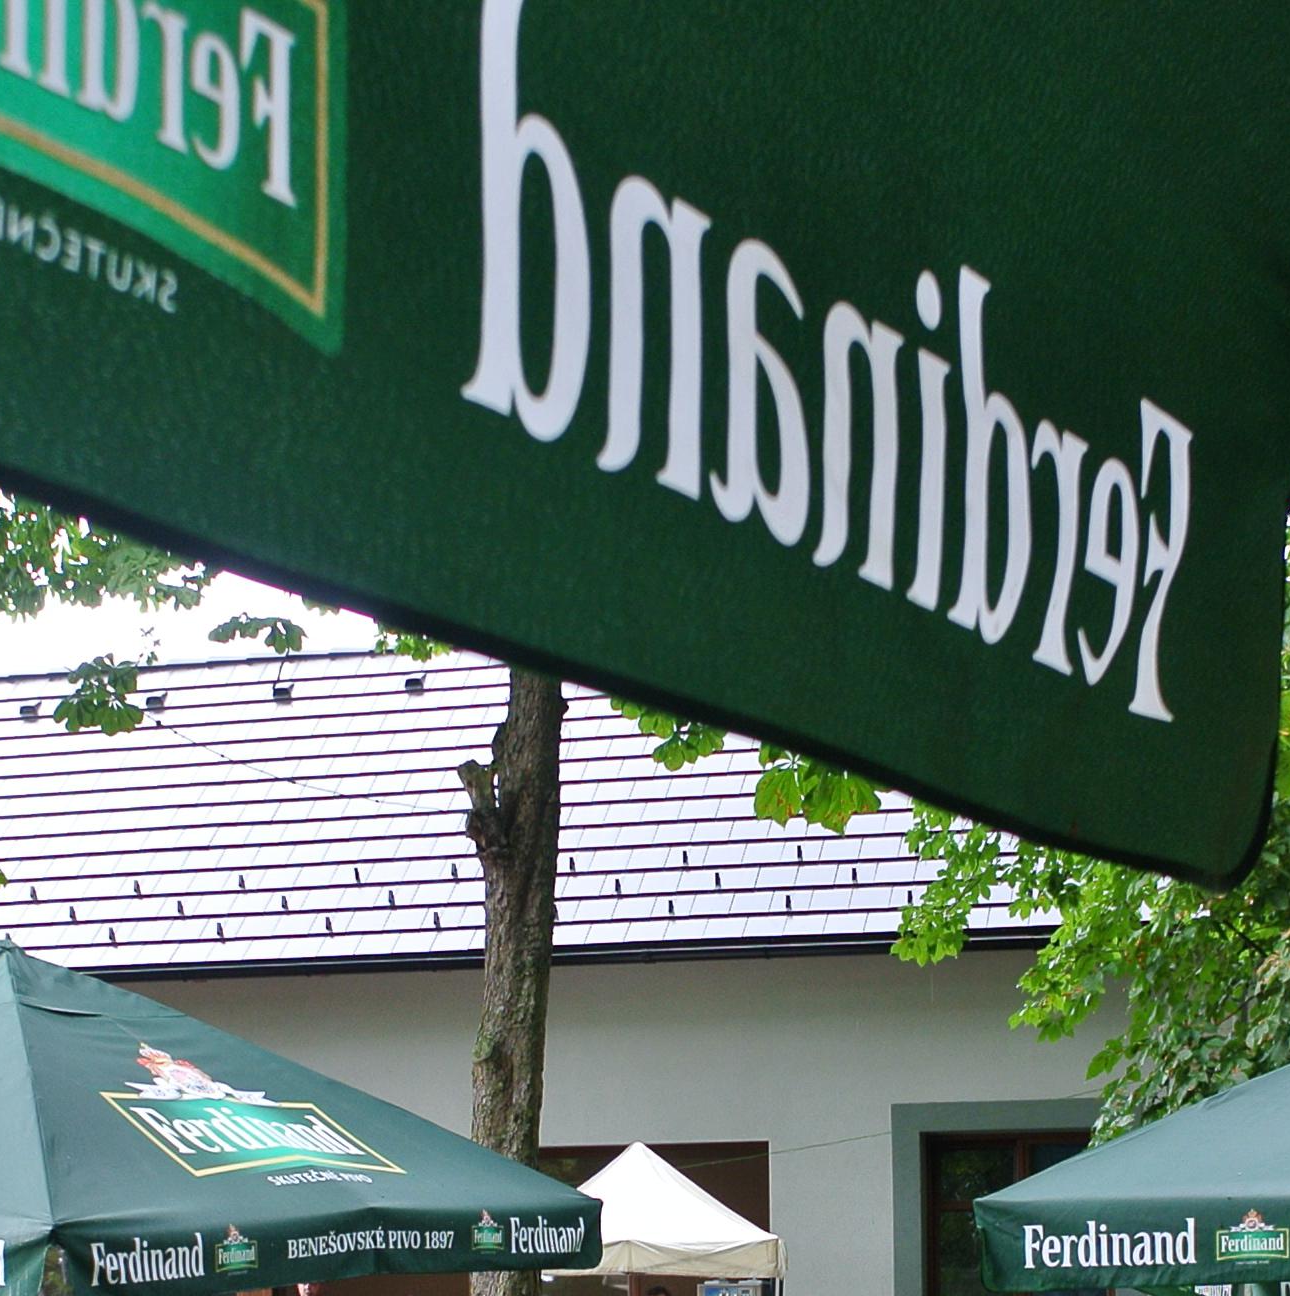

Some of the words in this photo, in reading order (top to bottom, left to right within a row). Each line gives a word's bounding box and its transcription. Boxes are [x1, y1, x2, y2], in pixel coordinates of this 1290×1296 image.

[129, 1106, 365, 1156] Ferdinand
[287, 1226, 386, 1259] BENEŠOVSKÉ
[388, 1230, 421, 1249] PIVO
[424, 1231, 455, 1249] 1897
[509, 1215, 585, 1254] Ferdinand
[1023, 1217, 1197, 1269] Ferdinand
[1220, 1233, 1285, 1253] Ferdinand
[90, 1231, 205, 1287] Ferdinand
